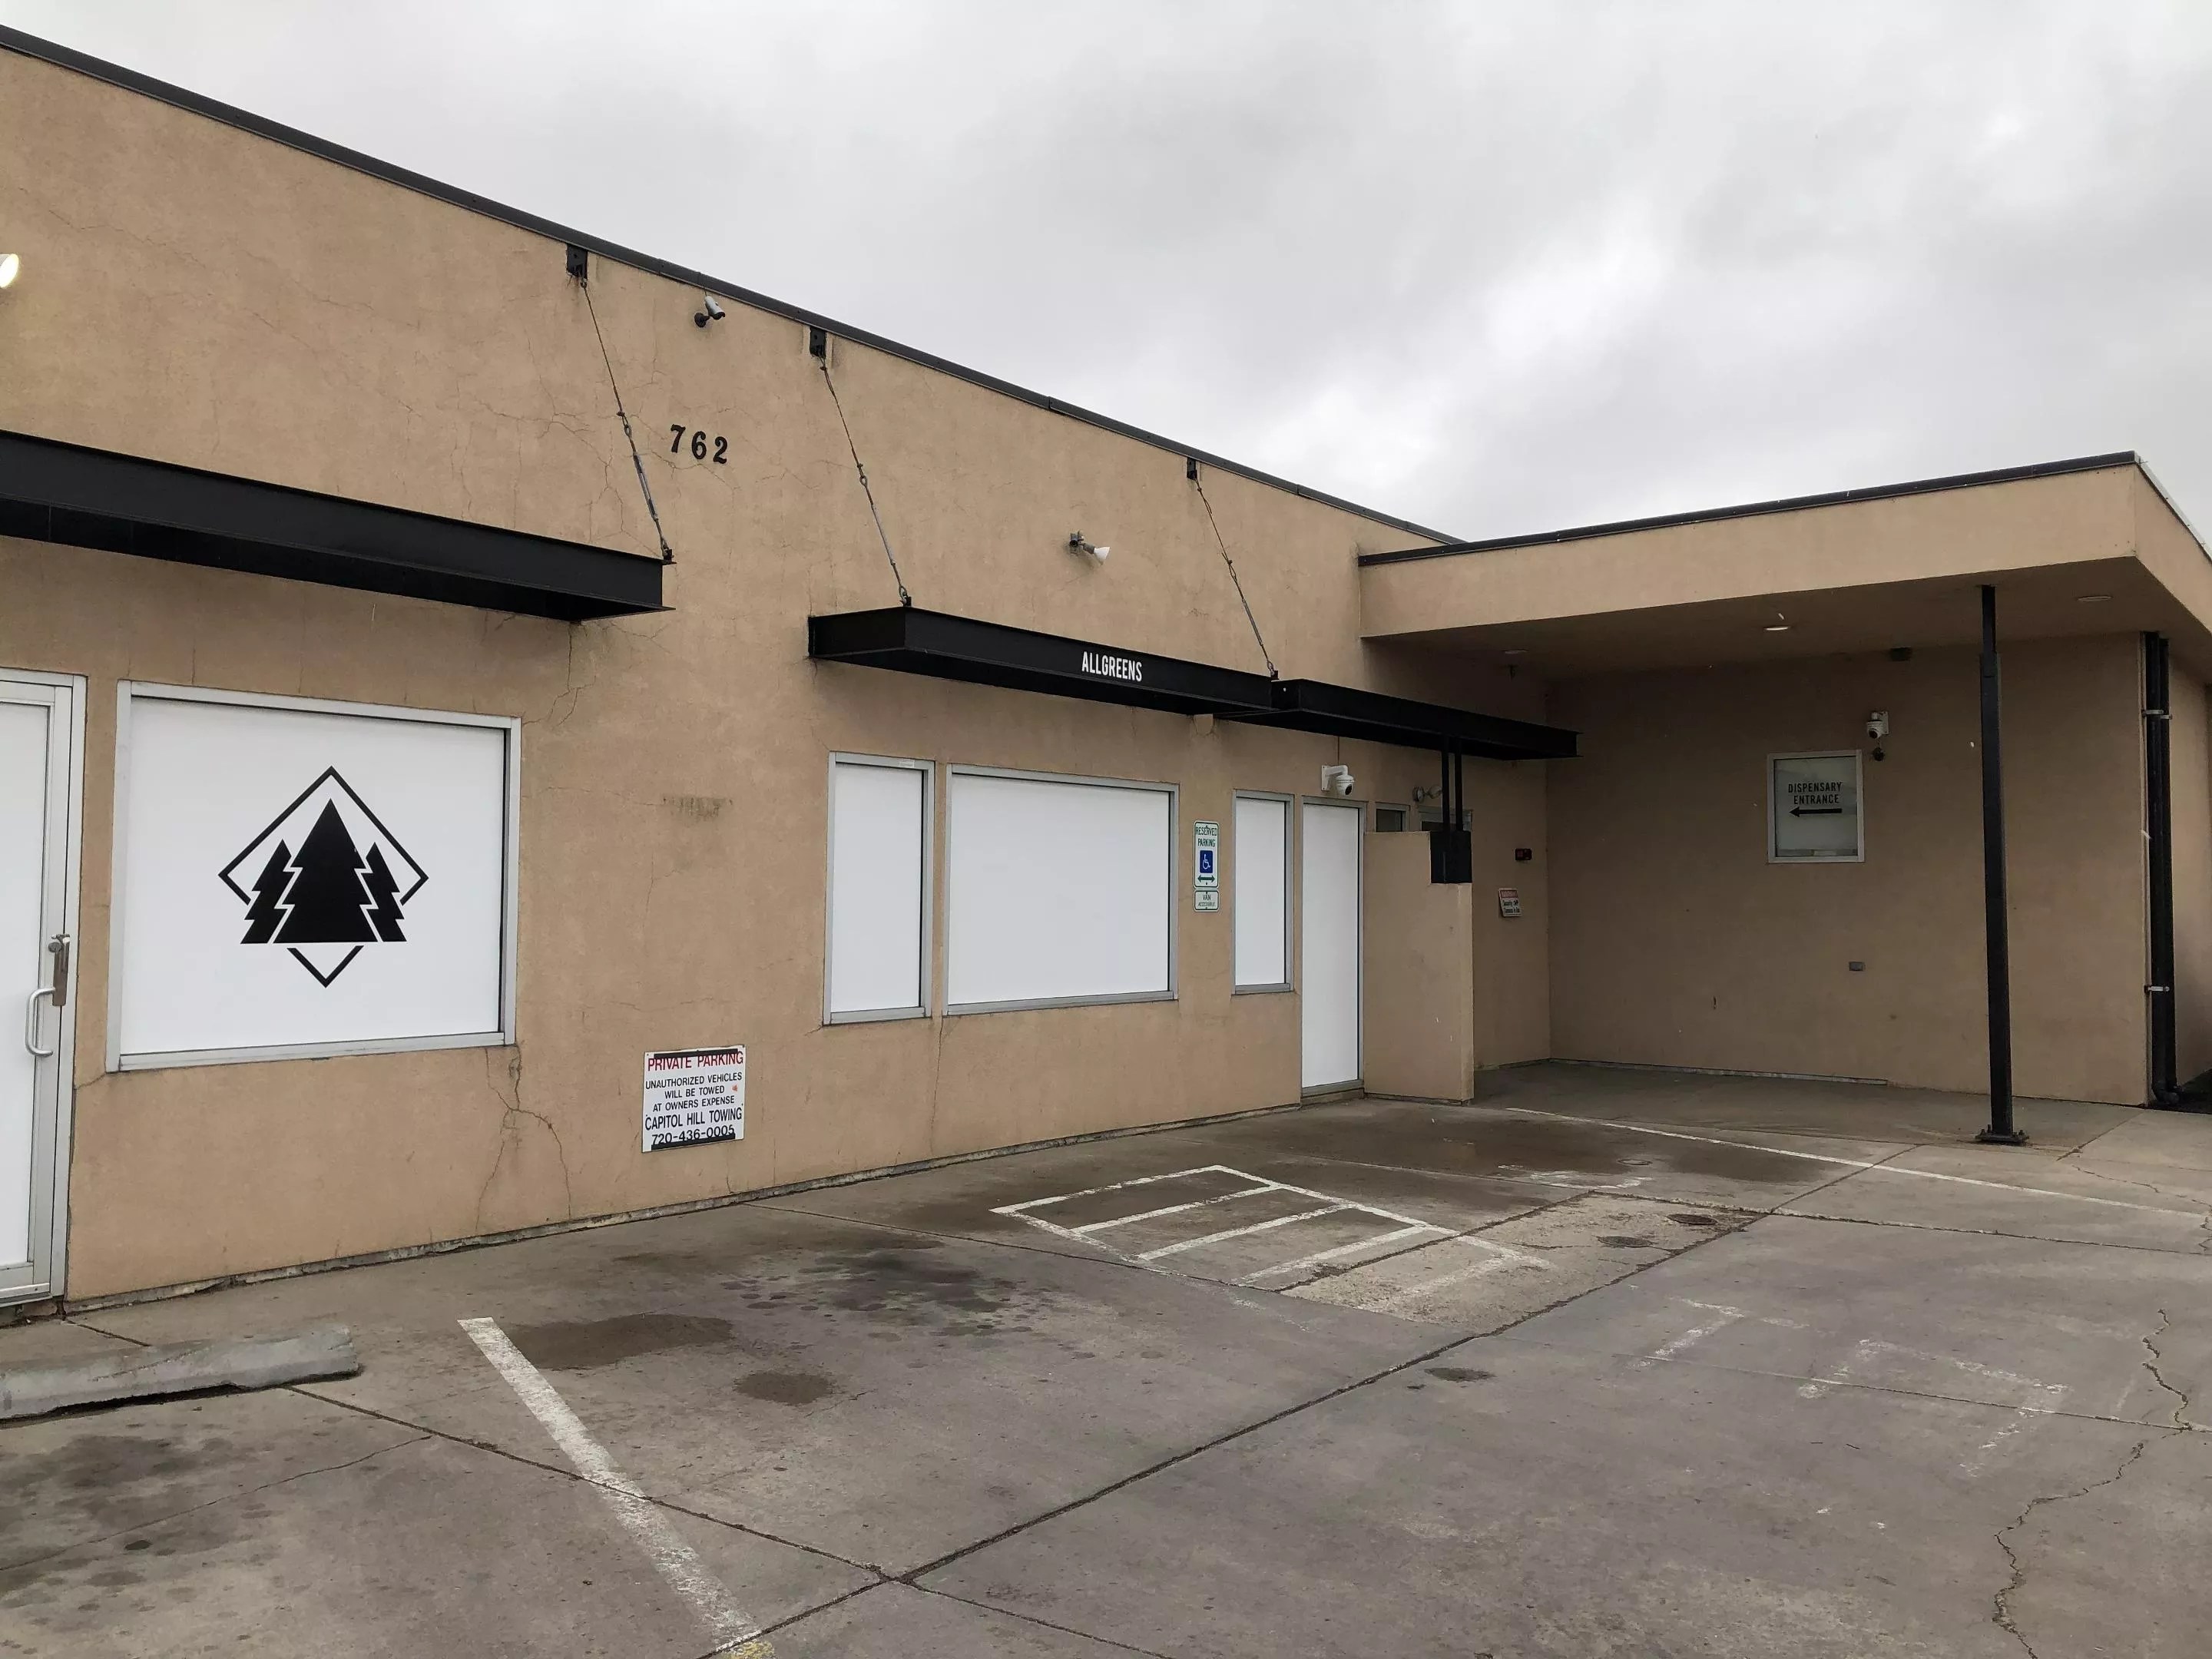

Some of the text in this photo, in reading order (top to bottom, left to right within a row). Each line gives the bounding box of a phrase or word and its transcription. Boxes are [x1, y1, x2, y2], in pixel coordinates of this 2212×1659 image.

[671, 424, 727, 465] 762
[1081, 651, 1142, 681] ALLGREENS
[1788, 782, 1842, 793] DISPENSARY
[1793, 794, 1839, 804] ENTRANCE
[1195, 826, 1217, 836] RESERVED
[1197, 838, 1216, 847] PARKING
[648, 1051, 743, 1071] PRIVATE PARKING
[646, 1071, 743, 1089] UNAUTHORIZED VEHICLES
[664, 1085, 725, 1099] WILL BE TOWED
[653, 1095, 735, 1112] AT OWNERS EXPENSE
[645, 1107, 742, 1131] CAPITOL HILL TOWING
[652, 1124, 735, 1145] 720-436-0005
